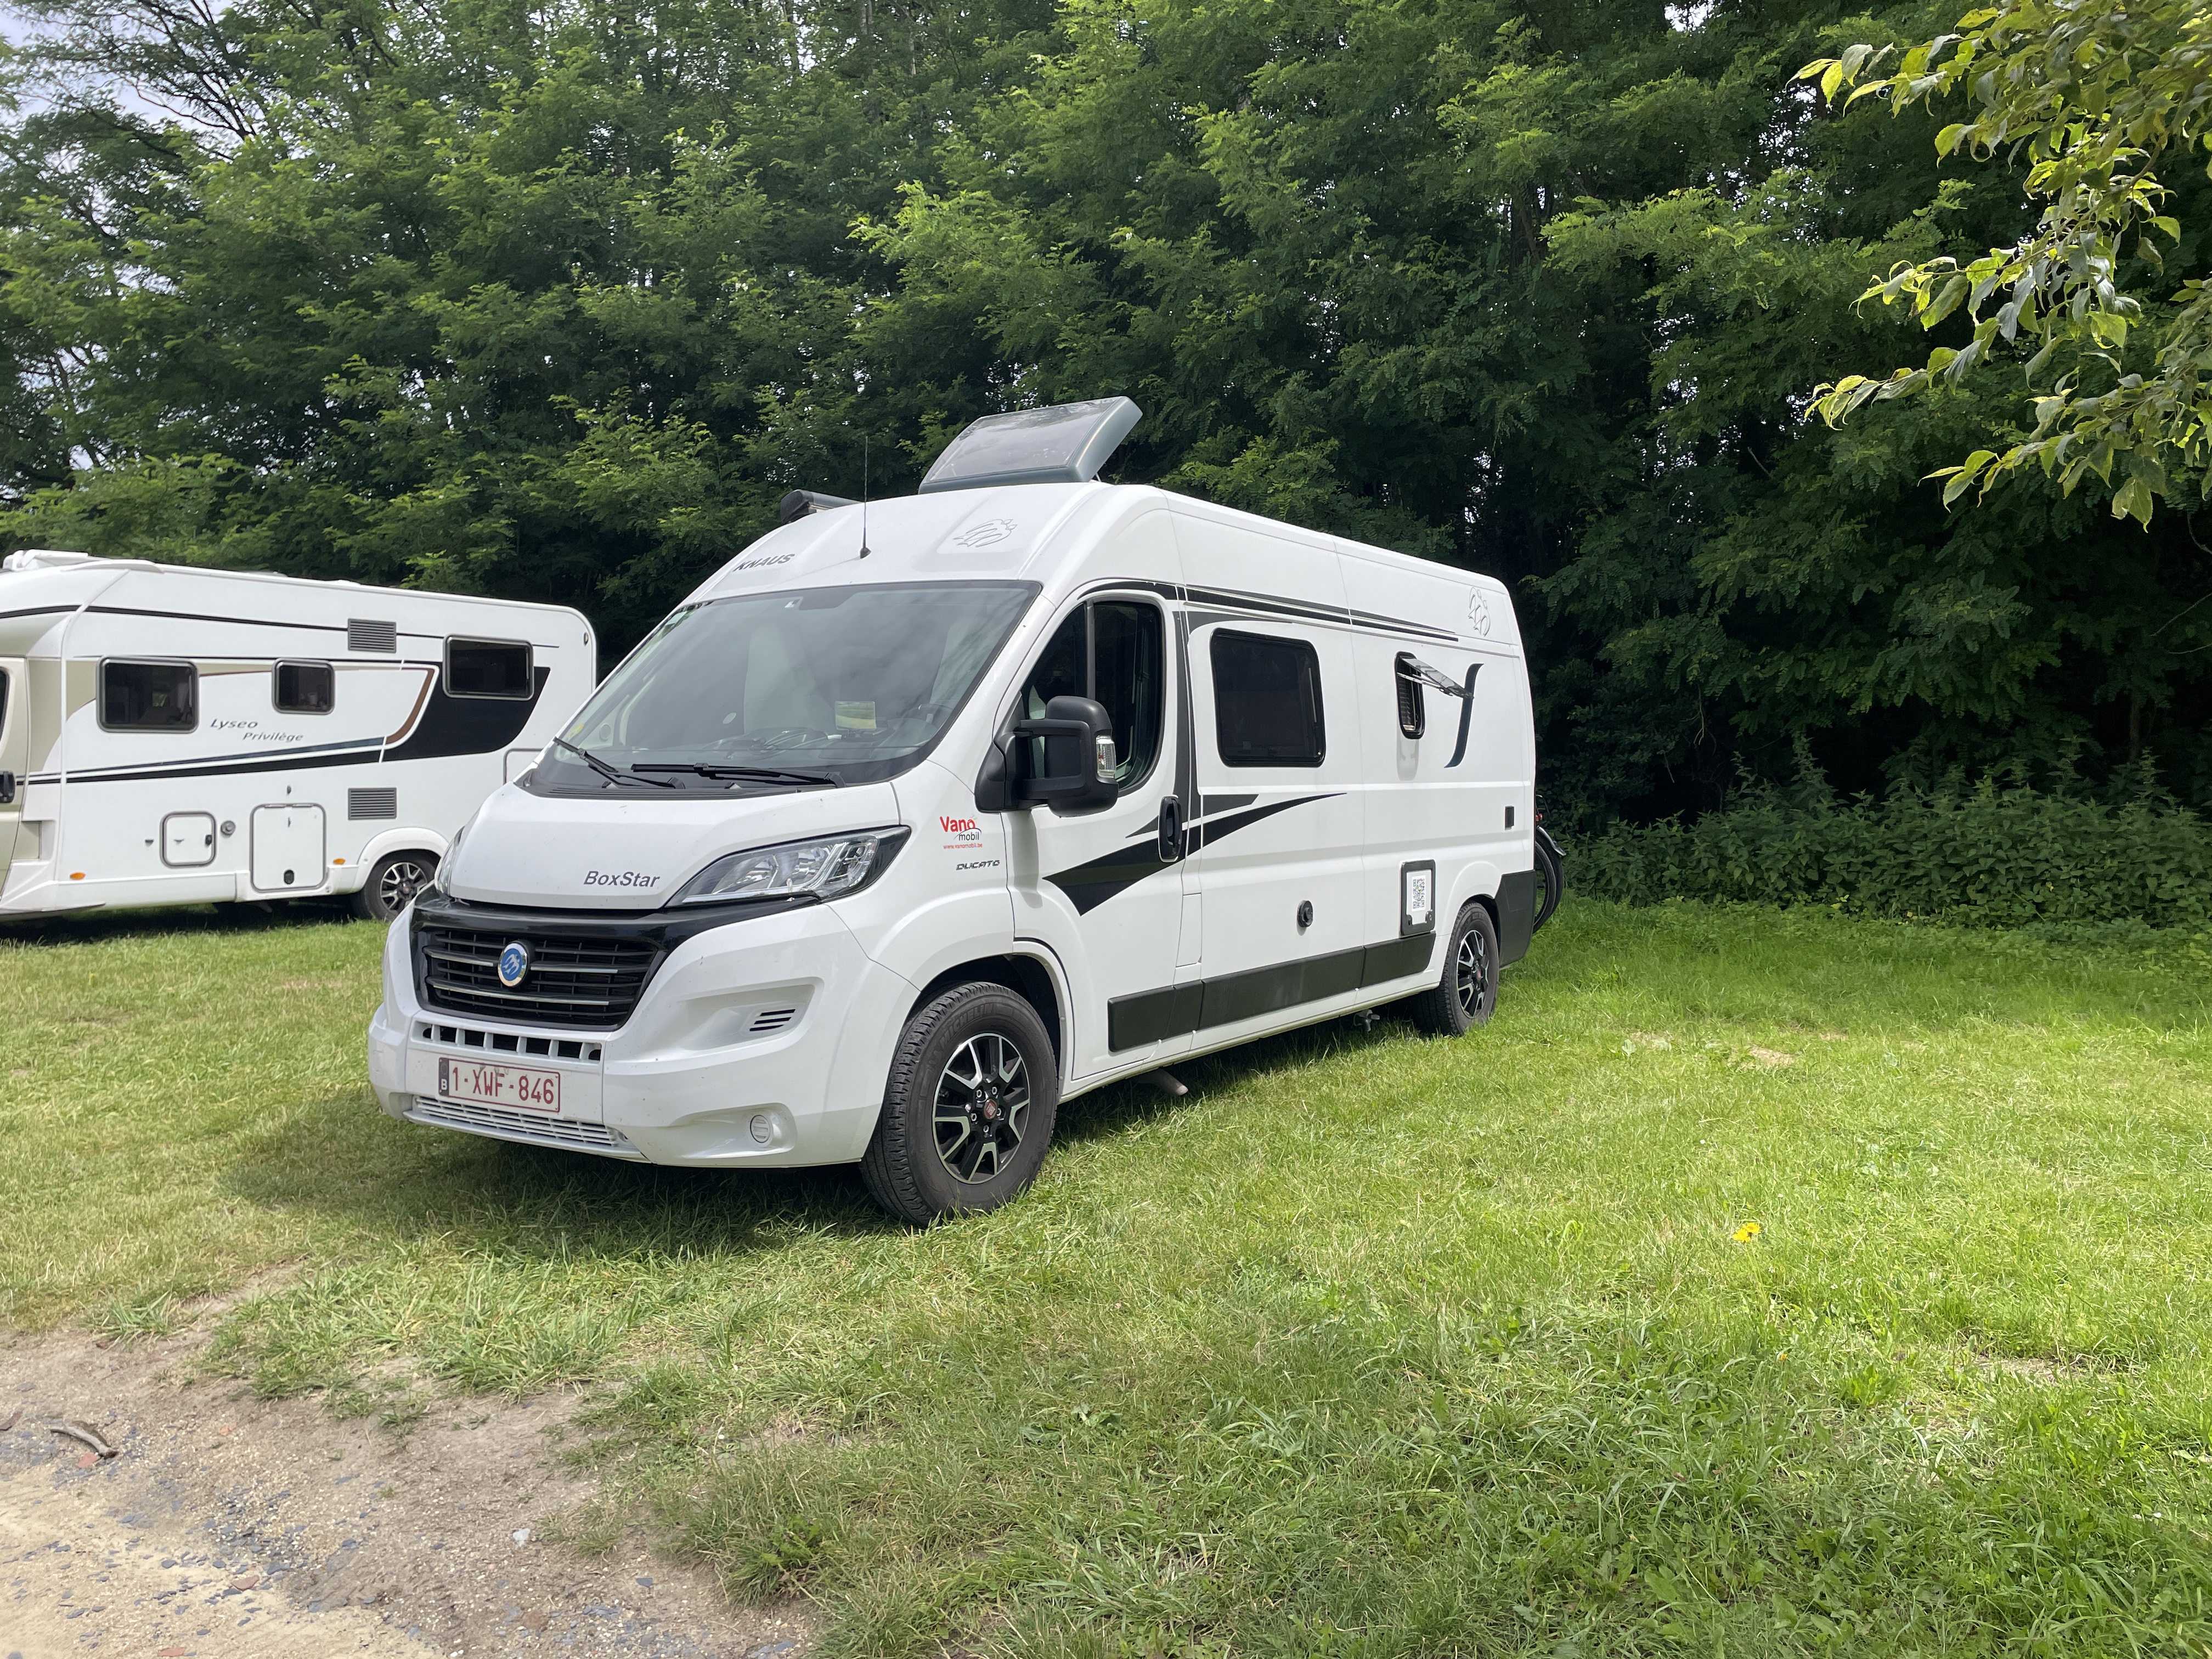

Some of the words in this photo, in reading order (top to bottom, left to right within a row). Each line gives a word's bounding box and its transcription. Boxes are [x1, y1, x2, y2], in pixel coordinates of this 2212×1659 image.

[732, 554, 795, 572] KNAUS
[210, 718, 258, 730] Lyseo
[242, 732, 304, 743] Privilège
[958, 832, 979, 841] mobil
[956, 860, 1000, 871] DUCATO
[583, 871, 661, 887] BoxStar
[441, 1078, 448, 1091] B
[452, 1066, 554, 1104] 1-XWF-846
